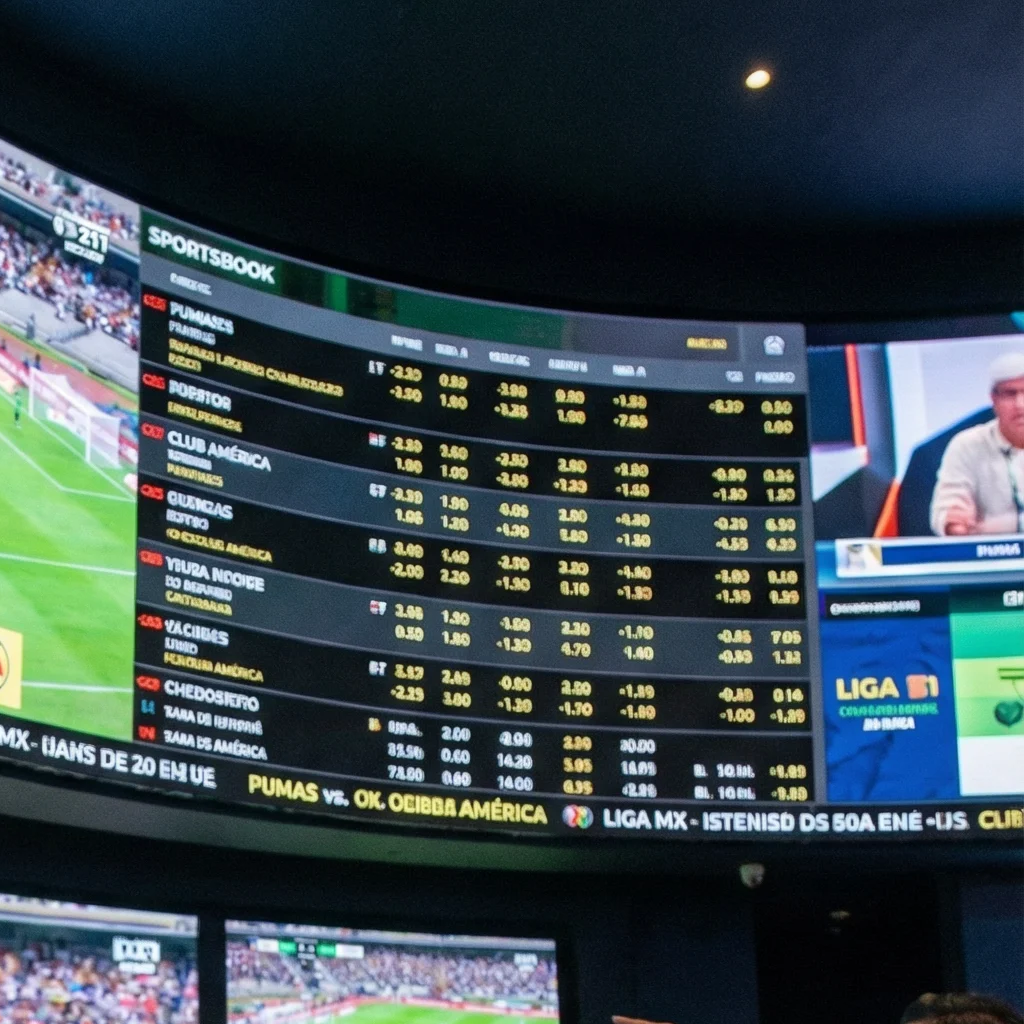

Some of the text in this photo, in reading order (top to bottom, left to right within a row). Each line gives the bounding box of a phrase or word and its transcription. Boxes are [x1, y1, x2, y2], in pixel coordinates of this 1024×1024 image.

[148, 225, 276, 285] SPORTSBOOK
[167, 430, 206, 454] CLUB
[207, 441, 272, 472] AMÉRICA
[836, 677, 900, 700] LIGA
[131, 753, 156, 777] 20
[248, 773, 319, 803] PUMAS
[458, 797, 548, 826] AMÉRICA
[603, 808, 651, 830] LIGA
[654, 810, 688, 831] MX
